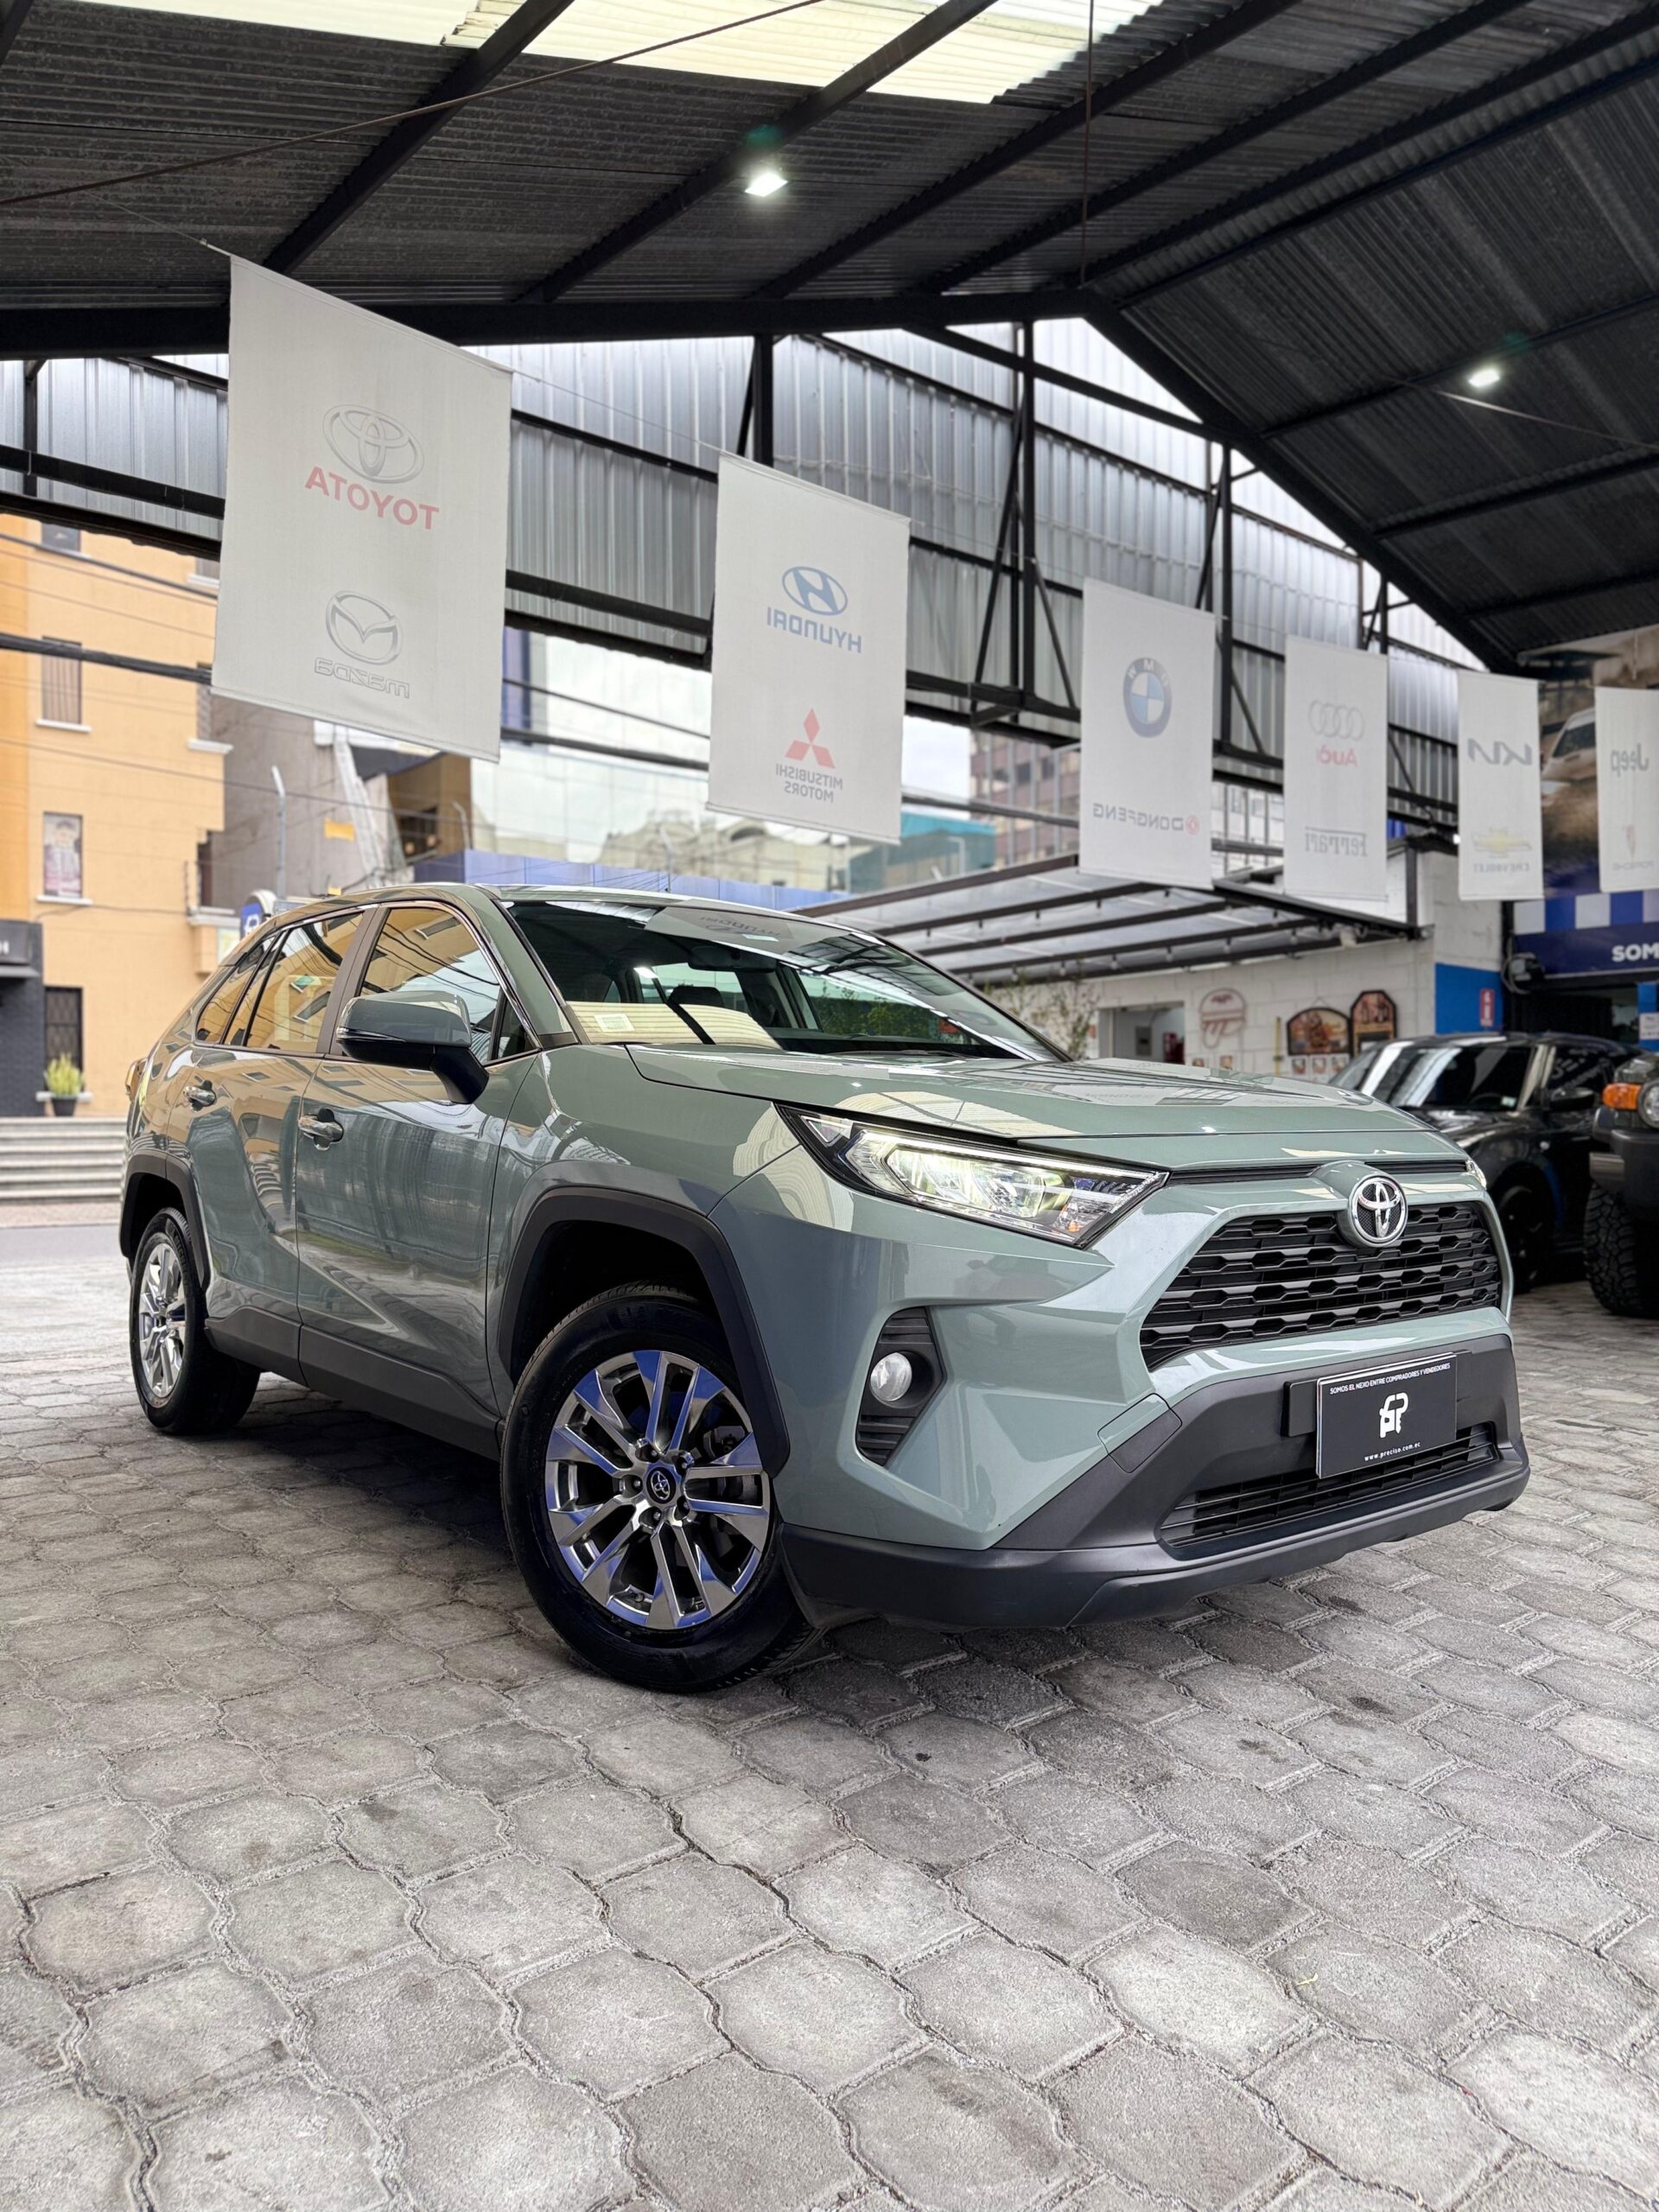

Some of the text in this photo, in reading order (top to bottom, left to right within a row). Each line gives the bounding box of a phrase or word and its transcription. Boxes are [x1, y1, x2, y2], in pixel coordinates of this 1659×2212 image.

[1330, 1384, 1349, 1395] SOMOS
[1356, 1381, 1370, 1389] NEXO
[1370, 1377, 1386, 1387] ENTRE
[1385, 1370, 1421, 1383] COMPRADORES
